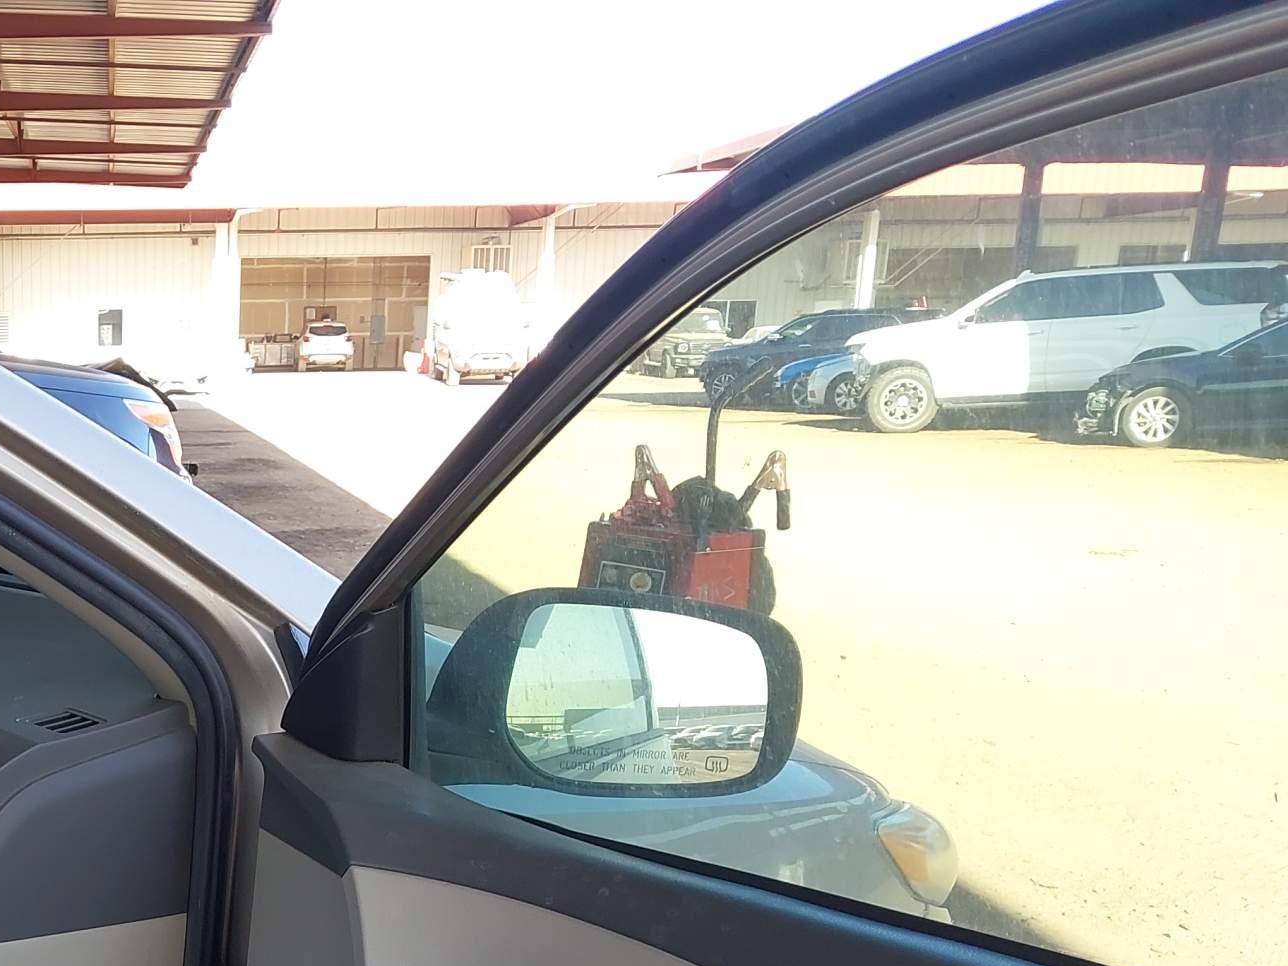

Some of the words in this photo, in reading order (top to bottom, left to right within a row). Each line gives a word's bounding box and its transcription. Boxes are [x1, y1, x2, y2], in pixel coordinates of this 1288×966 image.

[616, 748, 626, 758] IN
[632, 750, 666, 760] MIRROR
[672, 752, 690, 761] ARE
[559, 760, 595, 770] CLOSER
[602, 762, 625, 773] THAN
[632, 764, 654, 774] THEY
[661, 766, 696, 776] APPEAR
